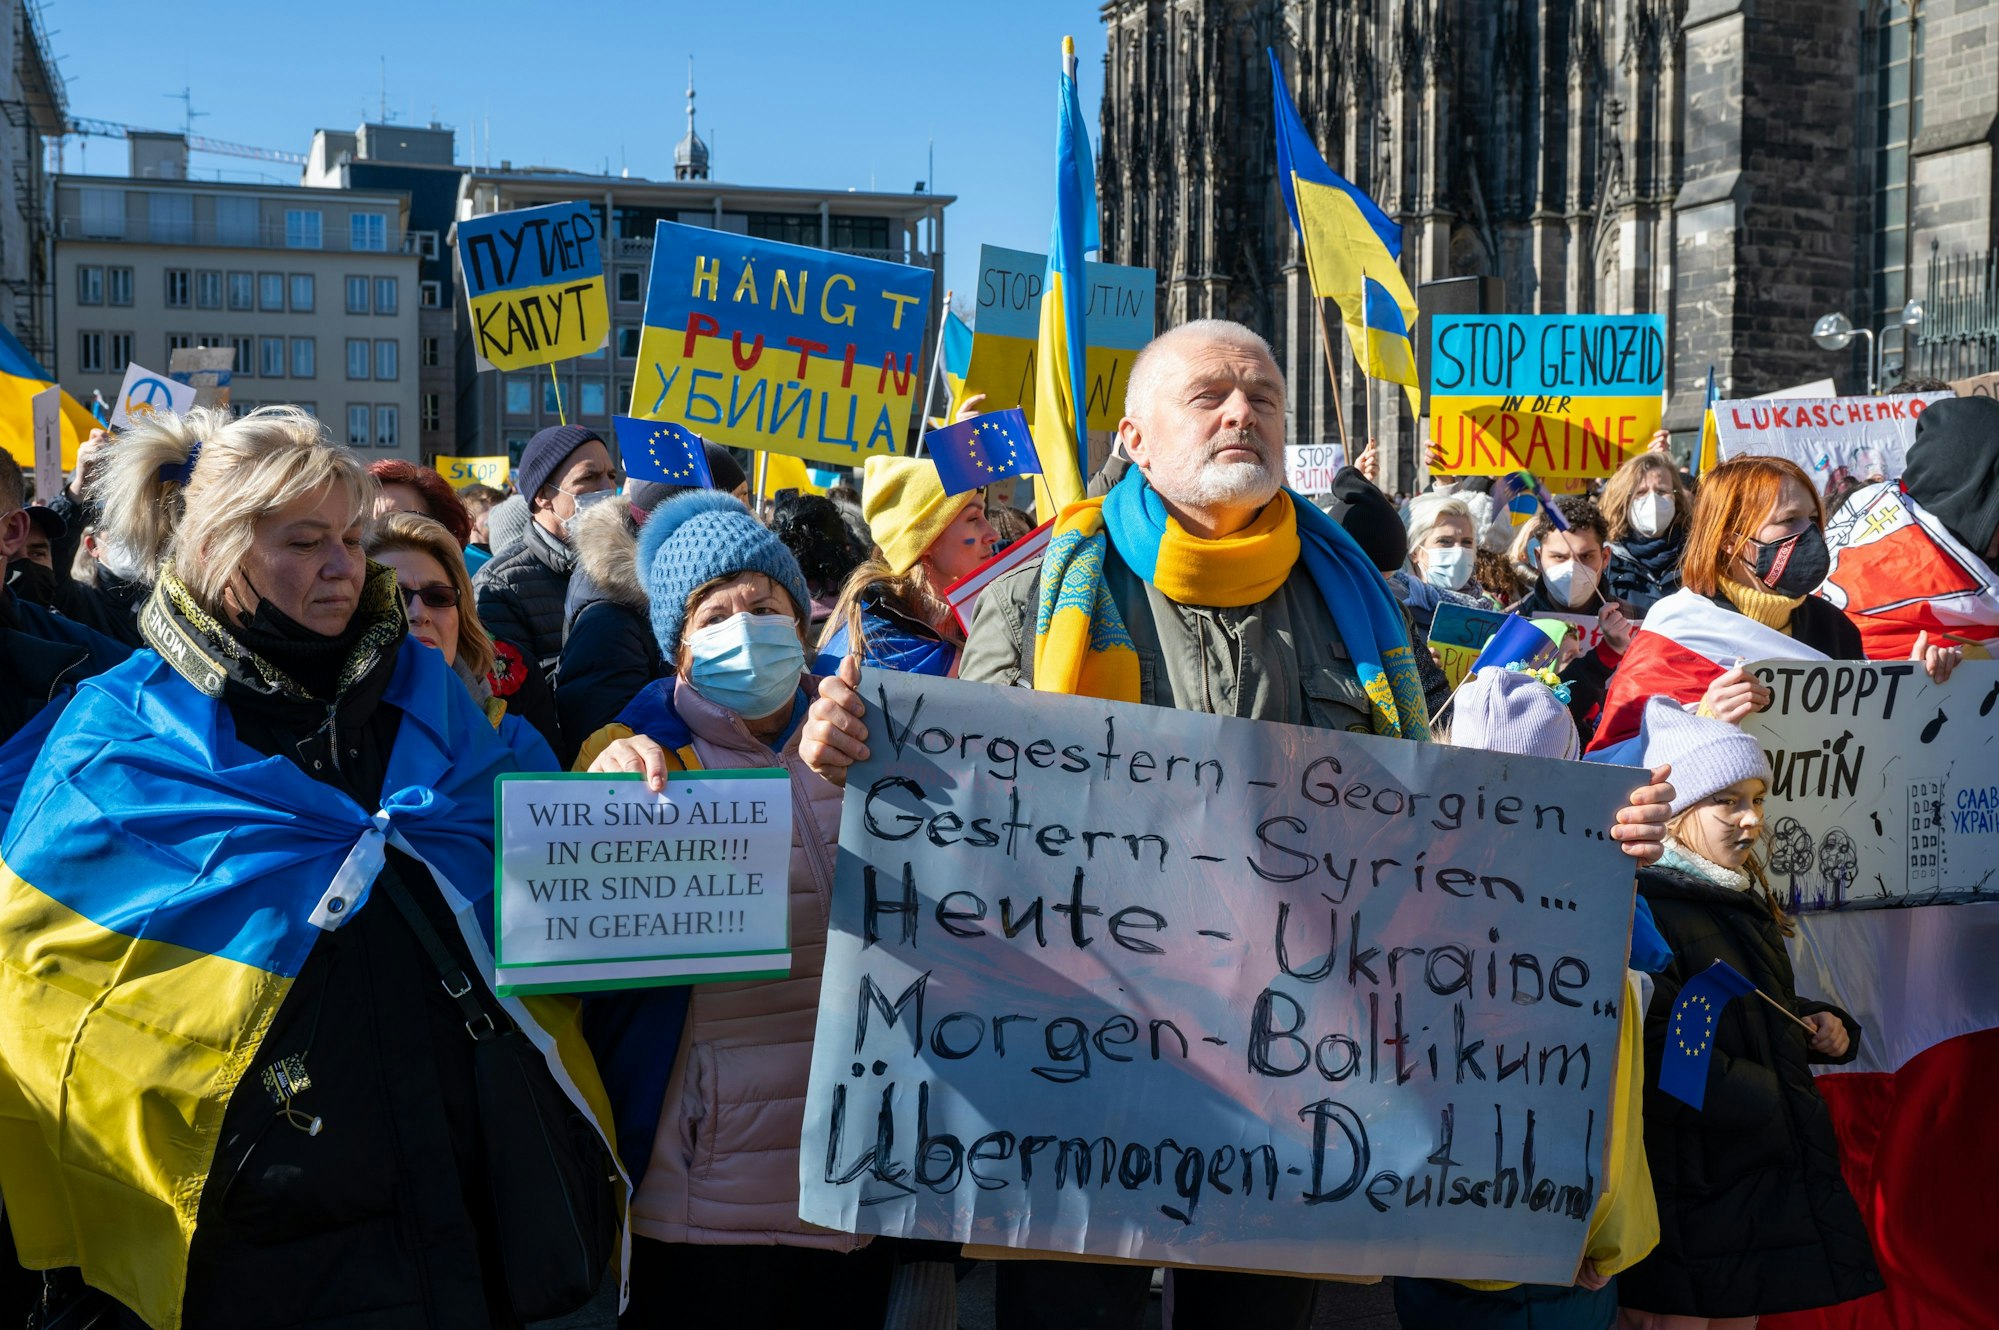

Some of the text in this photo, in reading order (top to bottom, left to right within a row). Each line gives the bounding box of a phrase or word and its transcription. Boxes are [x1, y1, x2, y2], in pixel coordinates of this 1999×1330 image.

[977, 268, 1042, 311] STOP
[475, 283, 594, 359] КАПУТ
[683, 311, 913, 396] PUTIN
[1436, 322, 1664, 389] STOP GENOZID
[652, 362, 897, 453] УБИЙЦА
[1500, 395, 1571, 413] IN DER
[1297, 447, 1333, 468] STOP
[1436, 413, 1637, 472] UKRAINE
[449, 462, 497, 480] STOP
[1295, 468, 1334, 489] PUTIN
[1754, 665, 1914, 720] STOPPT
[878, 682, 1224, 794] Vorgestern
[527, 801, 768, 827] WIR SIND ALLE
[1957, 786, 1999, 809] СЛАВ
[863, 775, 1170, 873] Gestern
[546, 838, 749, 865] IN GEFAHR!!!
[526, 873, 764, 903] WIR SIND ALLE
[863, 861, 1168, 955] Heute
[545, 910, 744, 941] IN GEFAHR!!!
[855, 970, 1188, 1083] Morgen
[1248, 987, 1592, 1091] Baltikum
